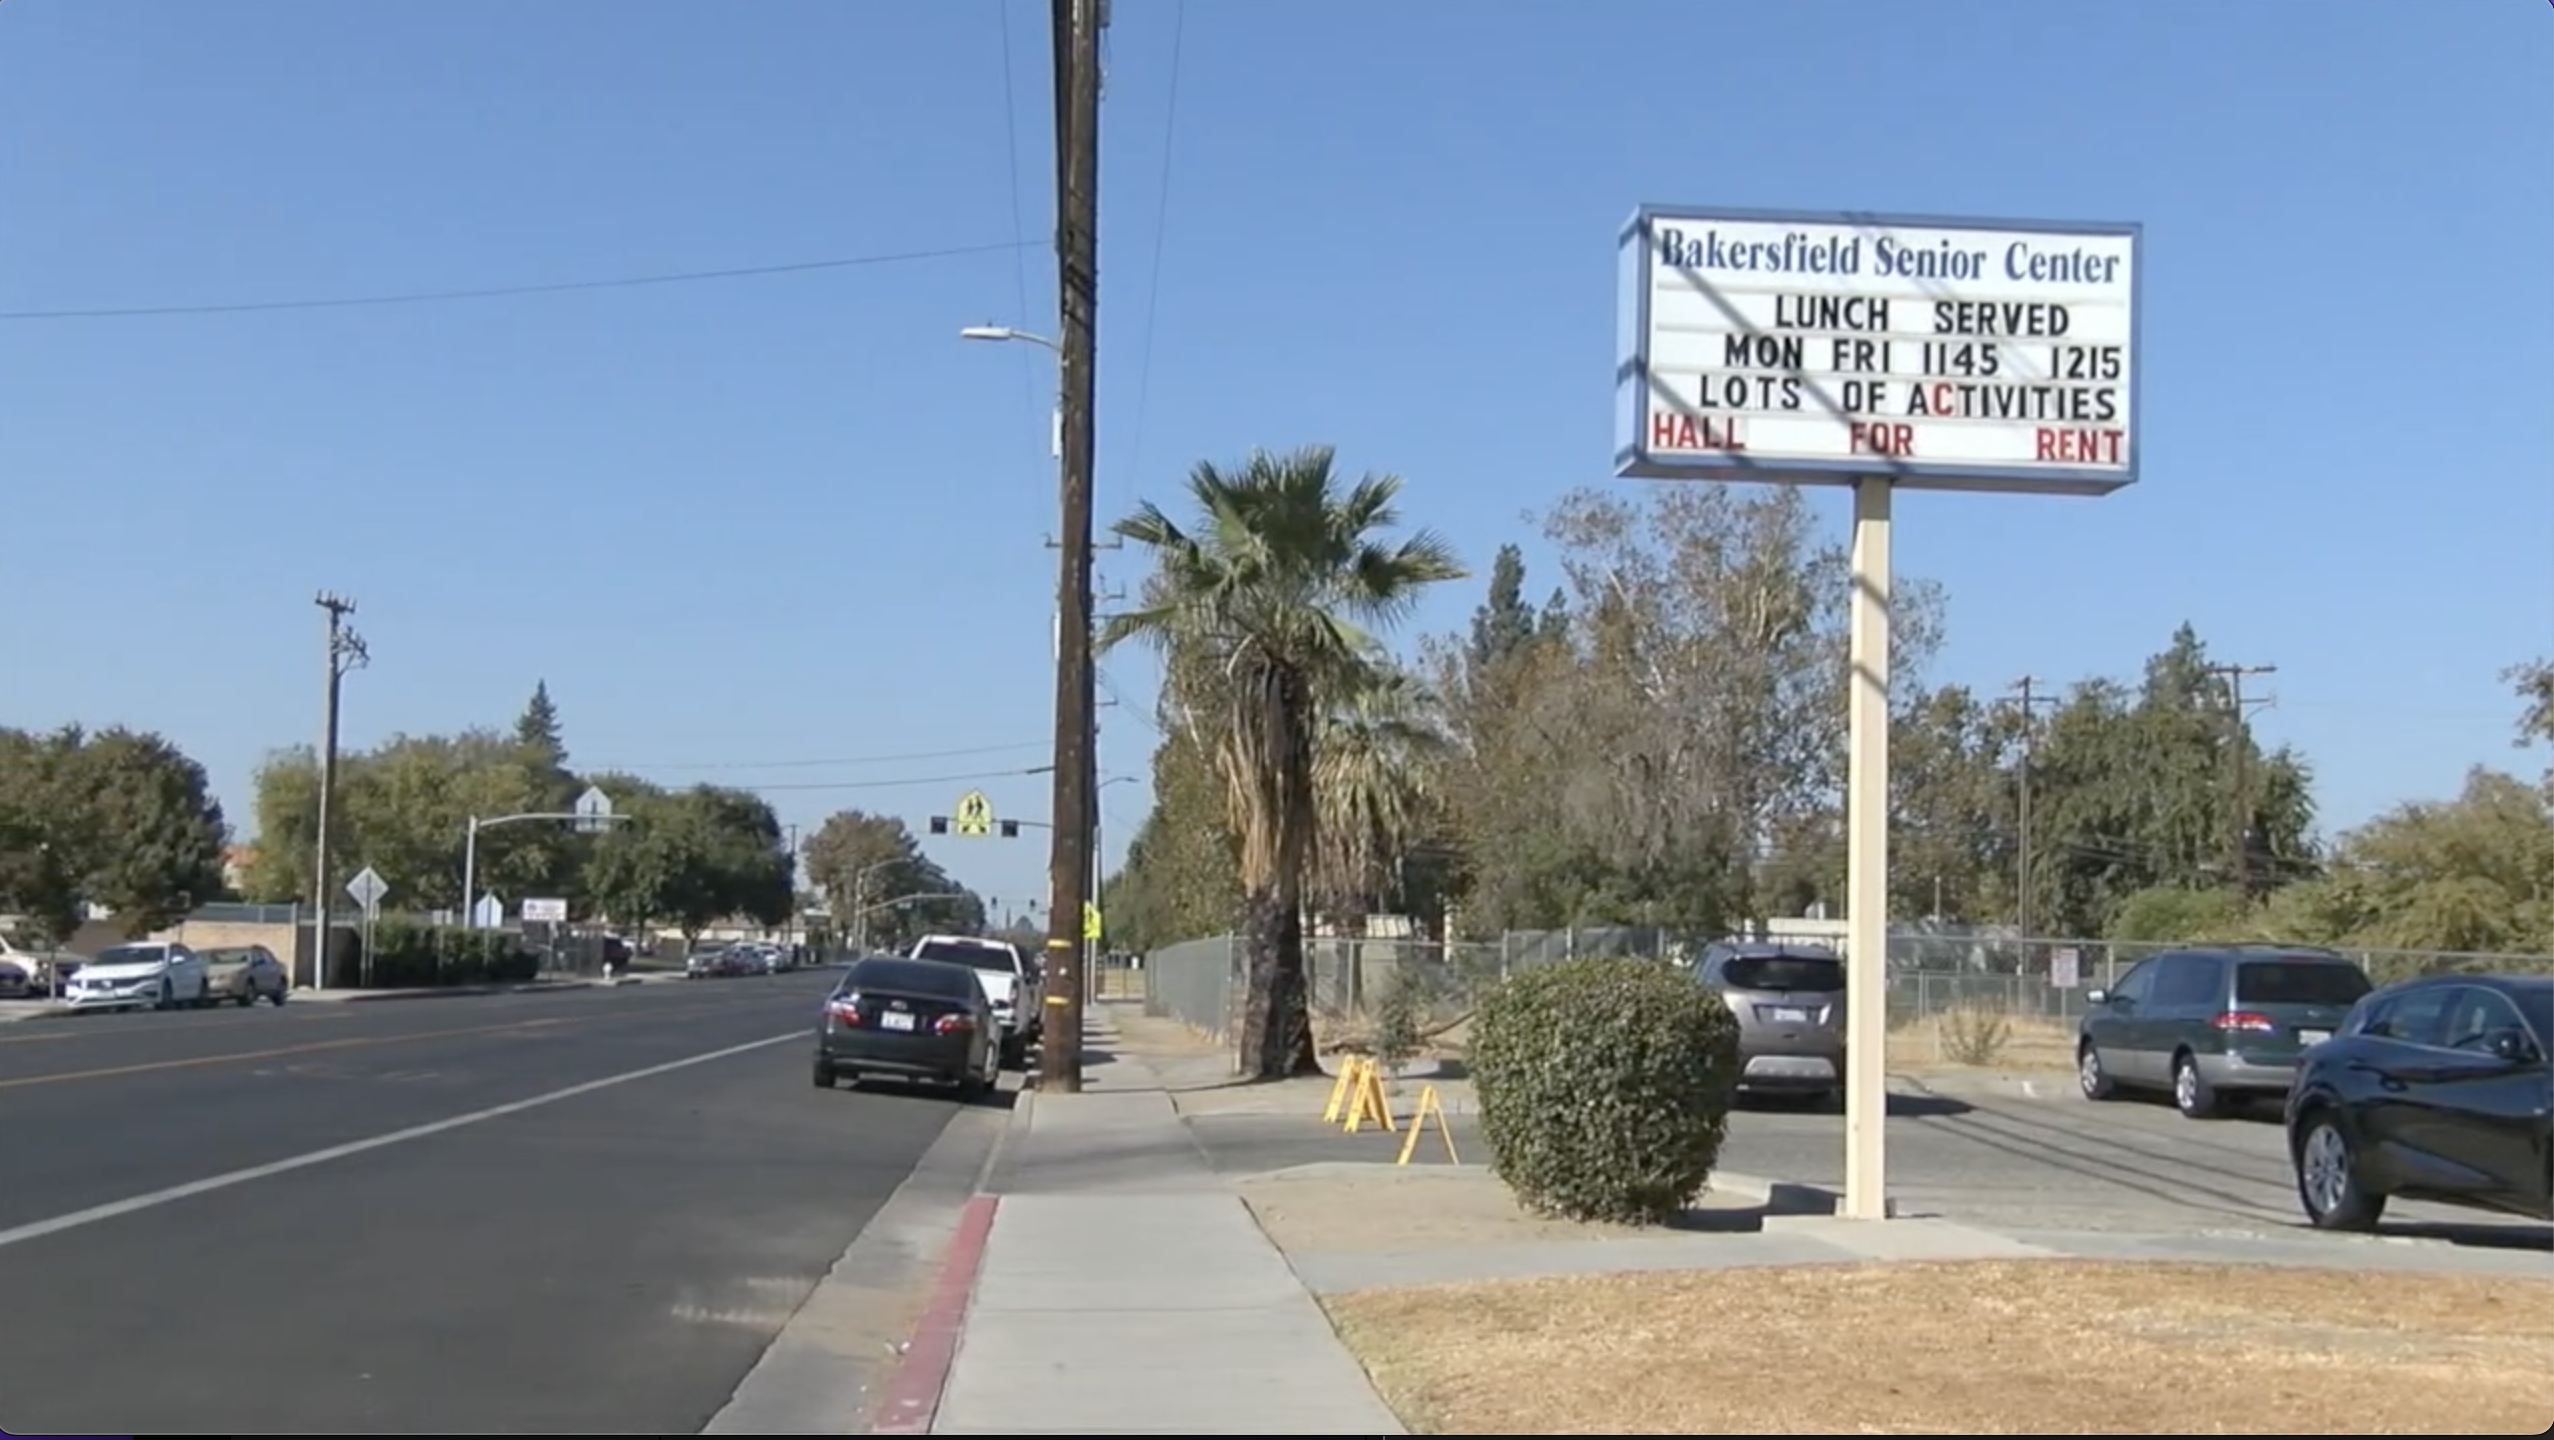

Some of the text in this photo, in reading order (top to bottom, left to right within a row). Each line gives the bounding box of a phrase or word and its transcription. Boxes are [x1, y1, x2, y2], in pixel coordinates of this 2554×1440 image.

[1661, 227, 2120, 284] Bakersfield Senior Center
[1775, 294, 2069, 337] LUNCH SERVED
[1724, 332, 2121, 380] MON FRI 1145 1215
[1700, 374, 2116, 421] LOTS OF ACTIVITIES
[1654, 411, 2124, 464] HALL FOR RENT
